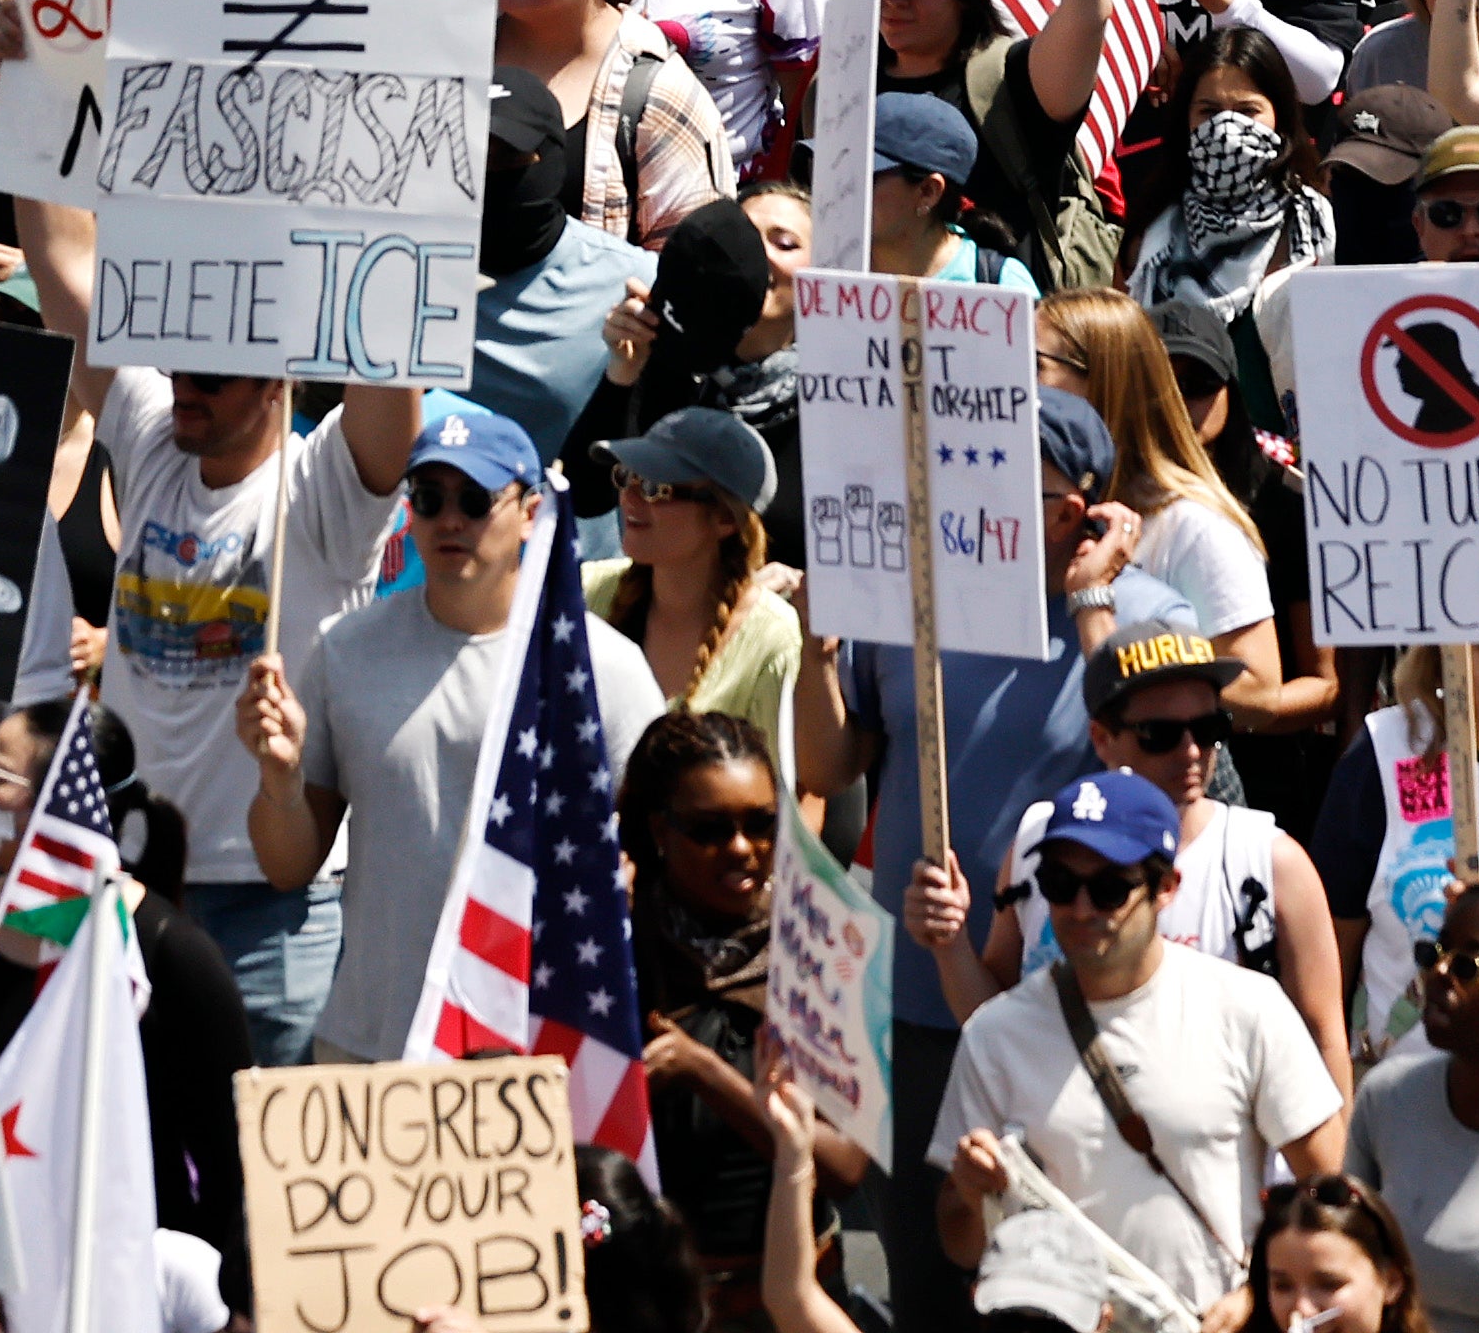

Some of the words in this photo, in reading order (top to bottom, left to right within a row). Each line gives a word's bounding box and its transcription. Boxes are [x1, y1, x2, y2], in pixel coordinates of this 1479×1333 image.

[98, 64, 478, 206] FASCISM
[98, 259, 284, 342] DELETE
[287, 228, 473, 378] ICE
[799, 276, 1018, 345] DEMOCRACY
[800, 375, 1027, 422] DICTATORSHIP
[868, 337, 955, 379] NOT
[260, 1076, 565, 1170] CONGRESS,
[286, 1175, 373, 1234] DO
[392, 1170, 533, 1226] YOUR
[288, 1231, 571, 1331] JOB!
